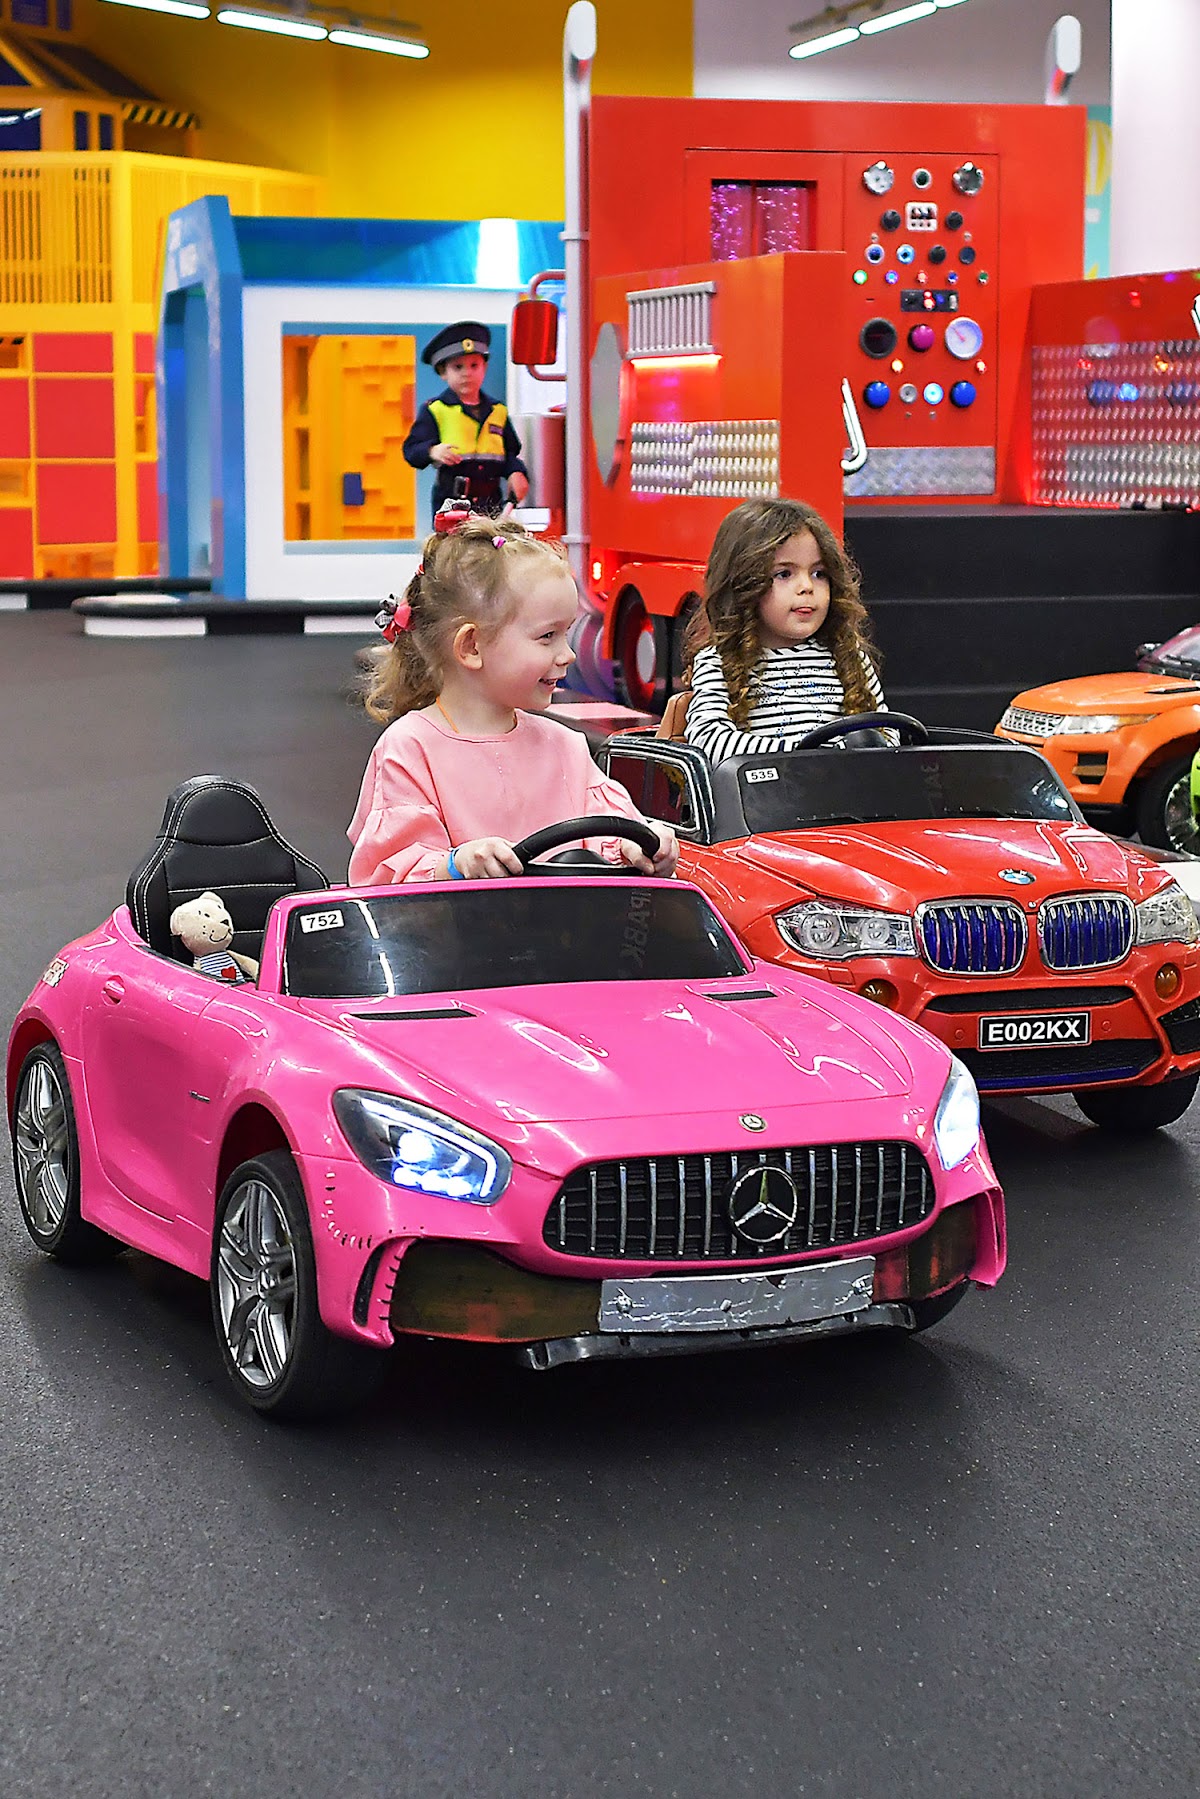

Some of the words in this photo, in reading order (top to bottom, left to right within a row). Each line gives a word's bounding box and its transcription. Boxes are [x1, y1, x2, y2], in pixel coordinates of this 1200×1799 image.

[751, 770, 775, 781] 535
[306, 913, 339, 929] 752
[988, 1019, 1081, 1042] E002KX
